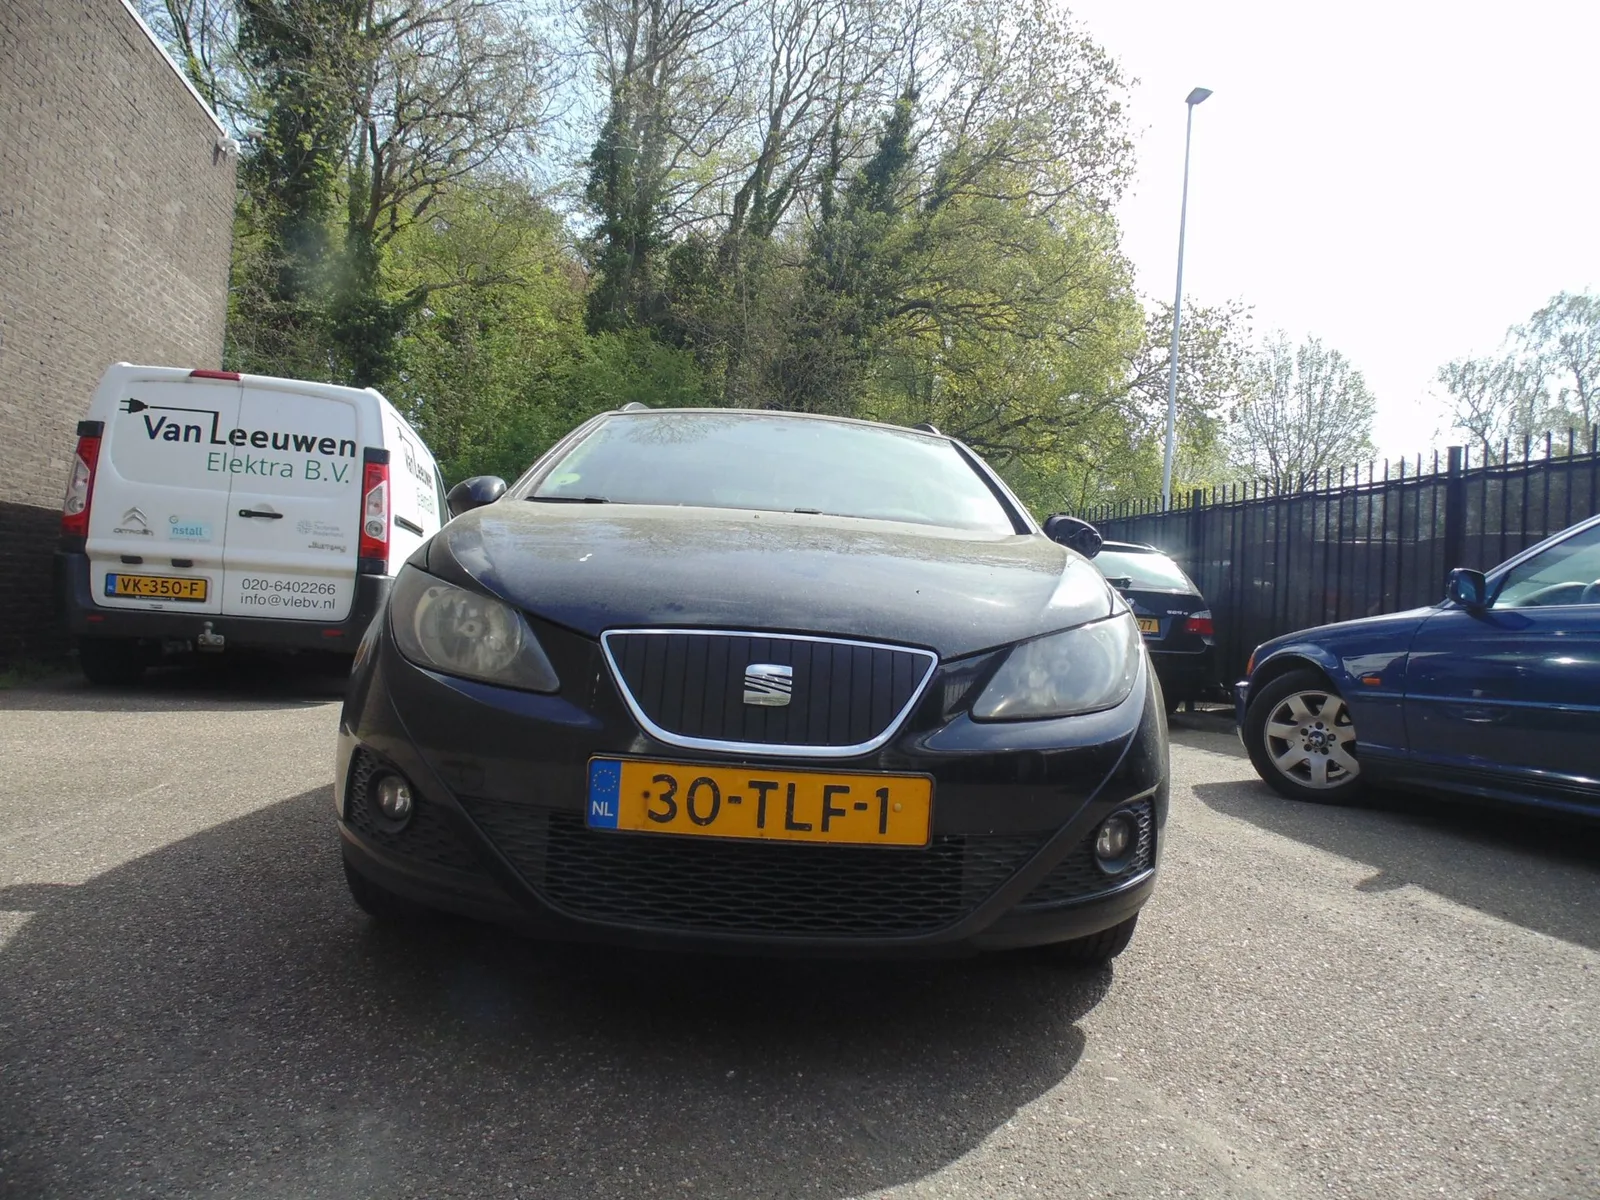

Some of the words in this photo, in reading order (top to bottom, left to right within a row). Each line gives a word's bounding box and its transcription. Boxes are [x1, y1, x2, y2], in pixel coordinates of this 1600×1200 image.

[144, 415, 202, 443] Van
[210, 412, 357, 458] Leeuwen
[207, 452, 293, 478] Elektra
[304, 460, 350, 484] B.V.
[121, 577, 200, 596] VK-350-F
[241, 578, 337, 596] 020-6402266
[240, 592, 336, 610] info@vlebv.nl
[592, 800, 614, 817] NL
[647, 773, 890, 834] 30-TLF-1
